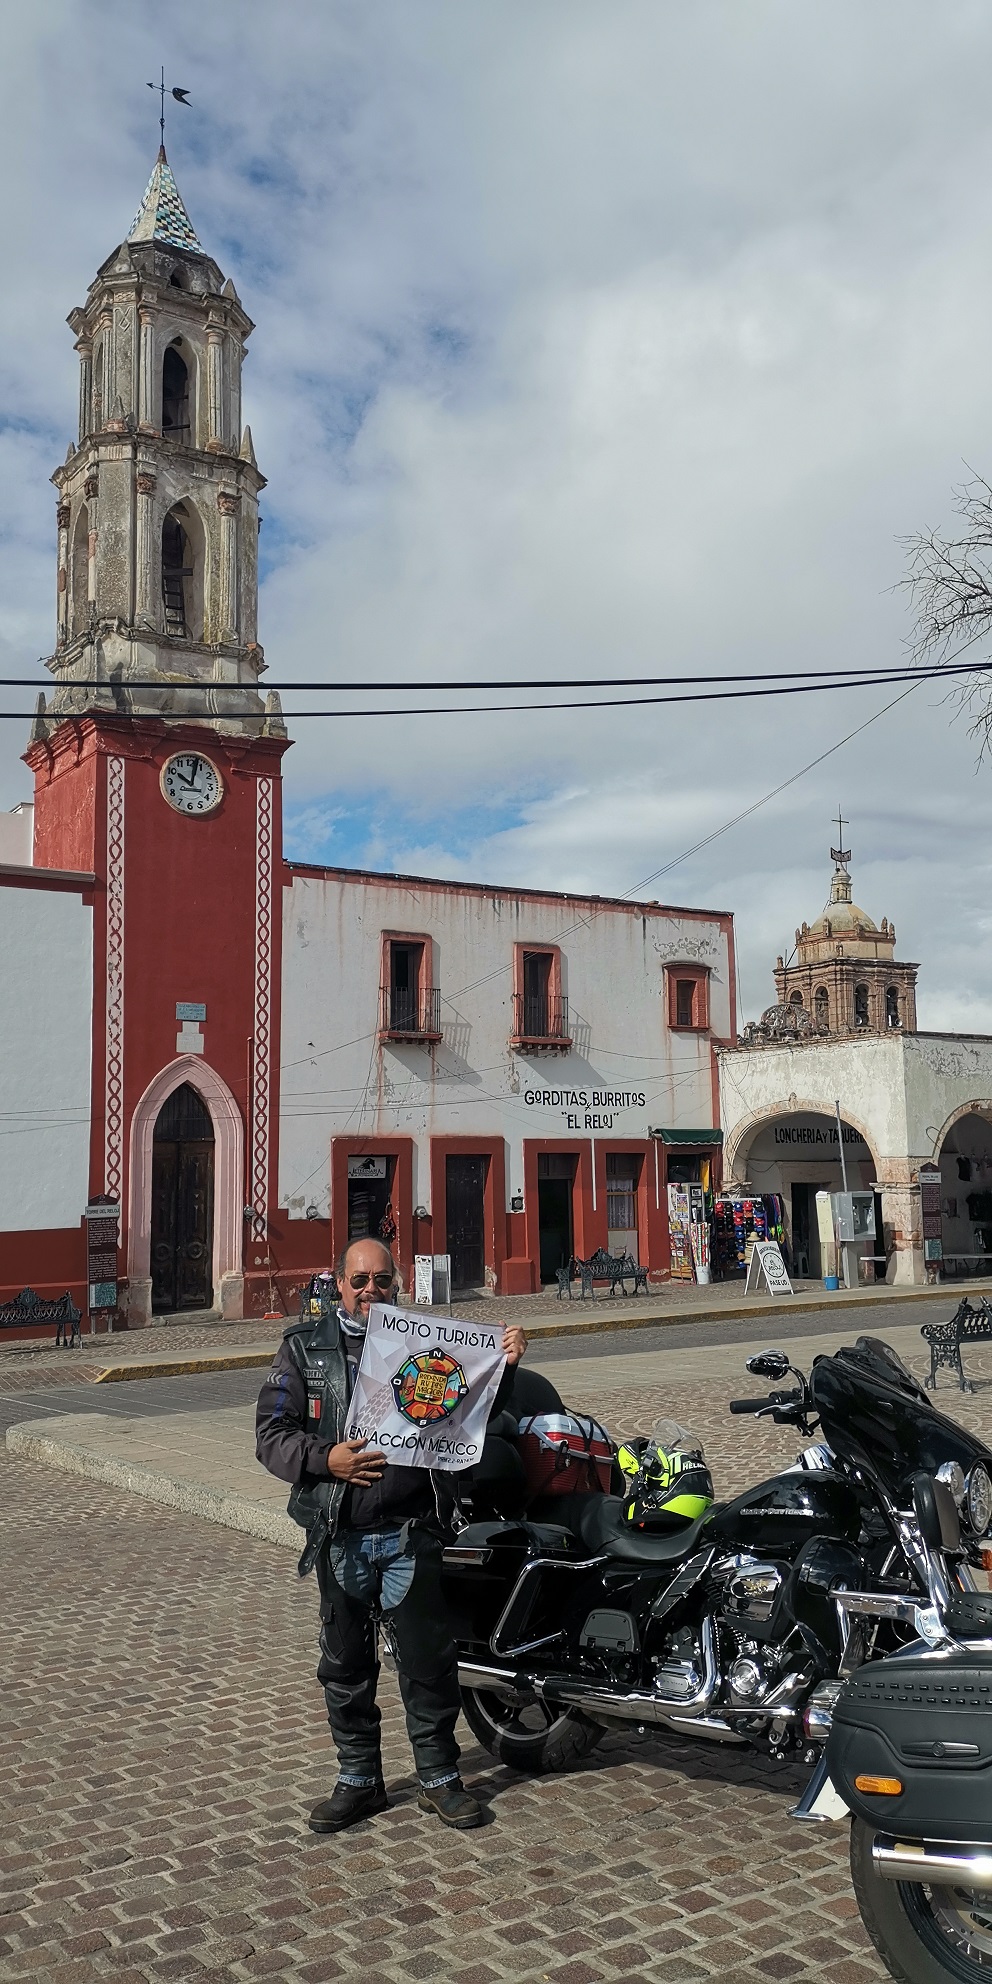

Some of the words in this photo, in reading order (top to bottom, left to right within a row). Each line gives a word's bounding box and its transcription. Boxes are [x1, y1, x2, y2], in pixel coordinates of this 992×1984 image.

[524, 1090, 587, 1106] GORDITAS
[592, 1091, 646, 1107] BURRITOS
[774, 1128, 821, 1144] LONCHERIA
[382, 1313, 431, 1338] MOTO
[436, 1326, 496, 1350] TURISTA
[433, 1350, 442, 1358] N
[348, 1425, 367, 1440] EN
[368, 1431, 426, 1451] ACCIÓN
[427, 1436, 478, 1456] MÉXICO
